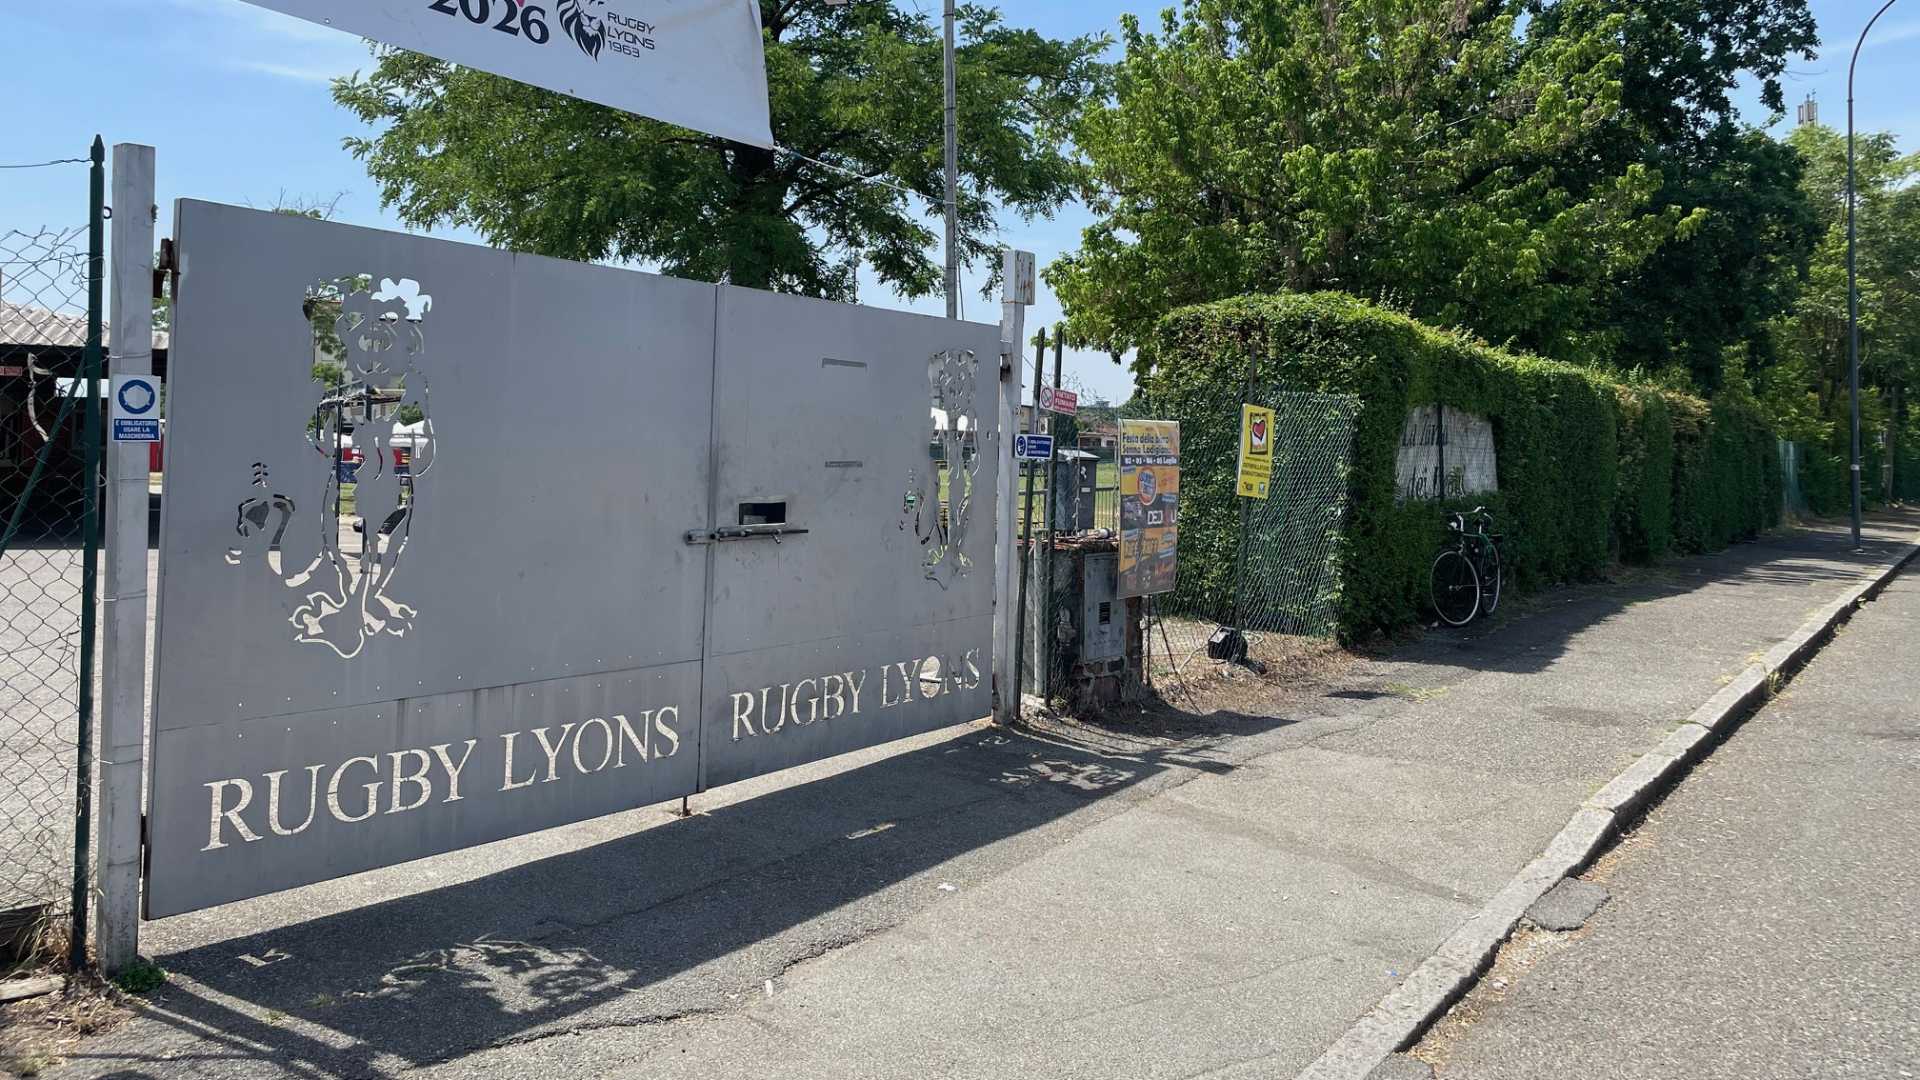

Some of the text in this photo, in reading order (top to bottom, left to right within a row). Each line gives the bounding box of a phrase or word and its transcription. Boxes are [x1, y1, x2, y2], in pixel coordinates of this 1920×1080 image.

[607, 11, 655, 35] RUGBY
[607, 26, 655, 50] LYONS
[608, 40, 640, 58] 1963
[729, 648, 980, 741] RUGBY LYONS
[200, 705, 680, 852] RUGBY LYONS
